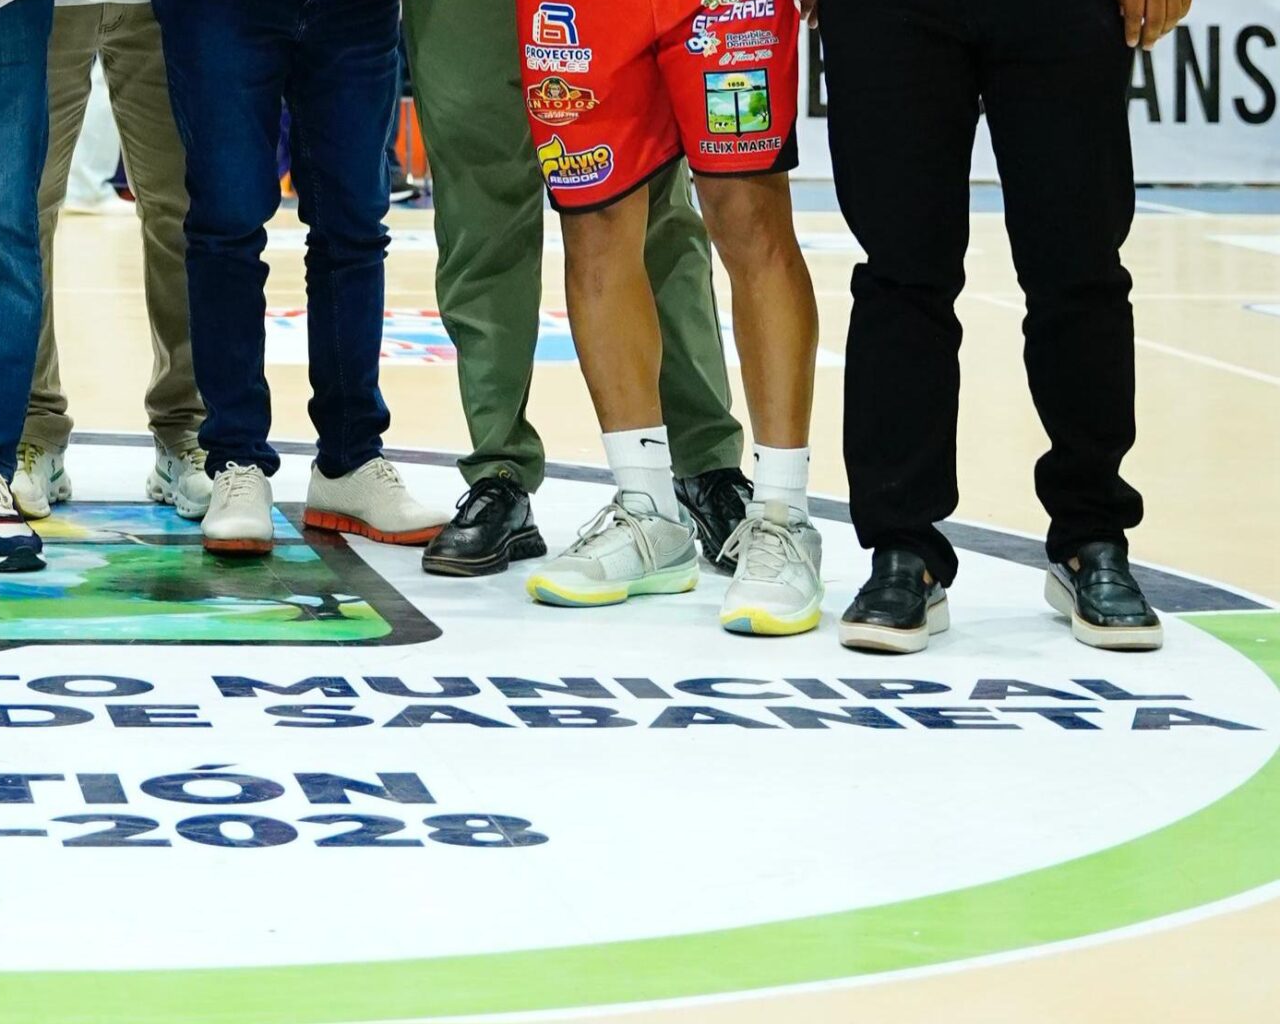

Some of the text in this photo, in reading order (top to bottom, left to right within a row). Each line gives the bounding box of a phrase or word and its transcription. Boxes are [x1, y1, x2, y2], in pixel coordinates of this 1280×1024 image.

[526, 45, 591, 60] PROYECTOS
[700, 136, 782, 154] FELIX MARTE
[550, 171, 599, 184] REGIDOR
[210, 675, 1188, 701] MUNICIPAL
[263, 704, 1264, 731] SABANETA
